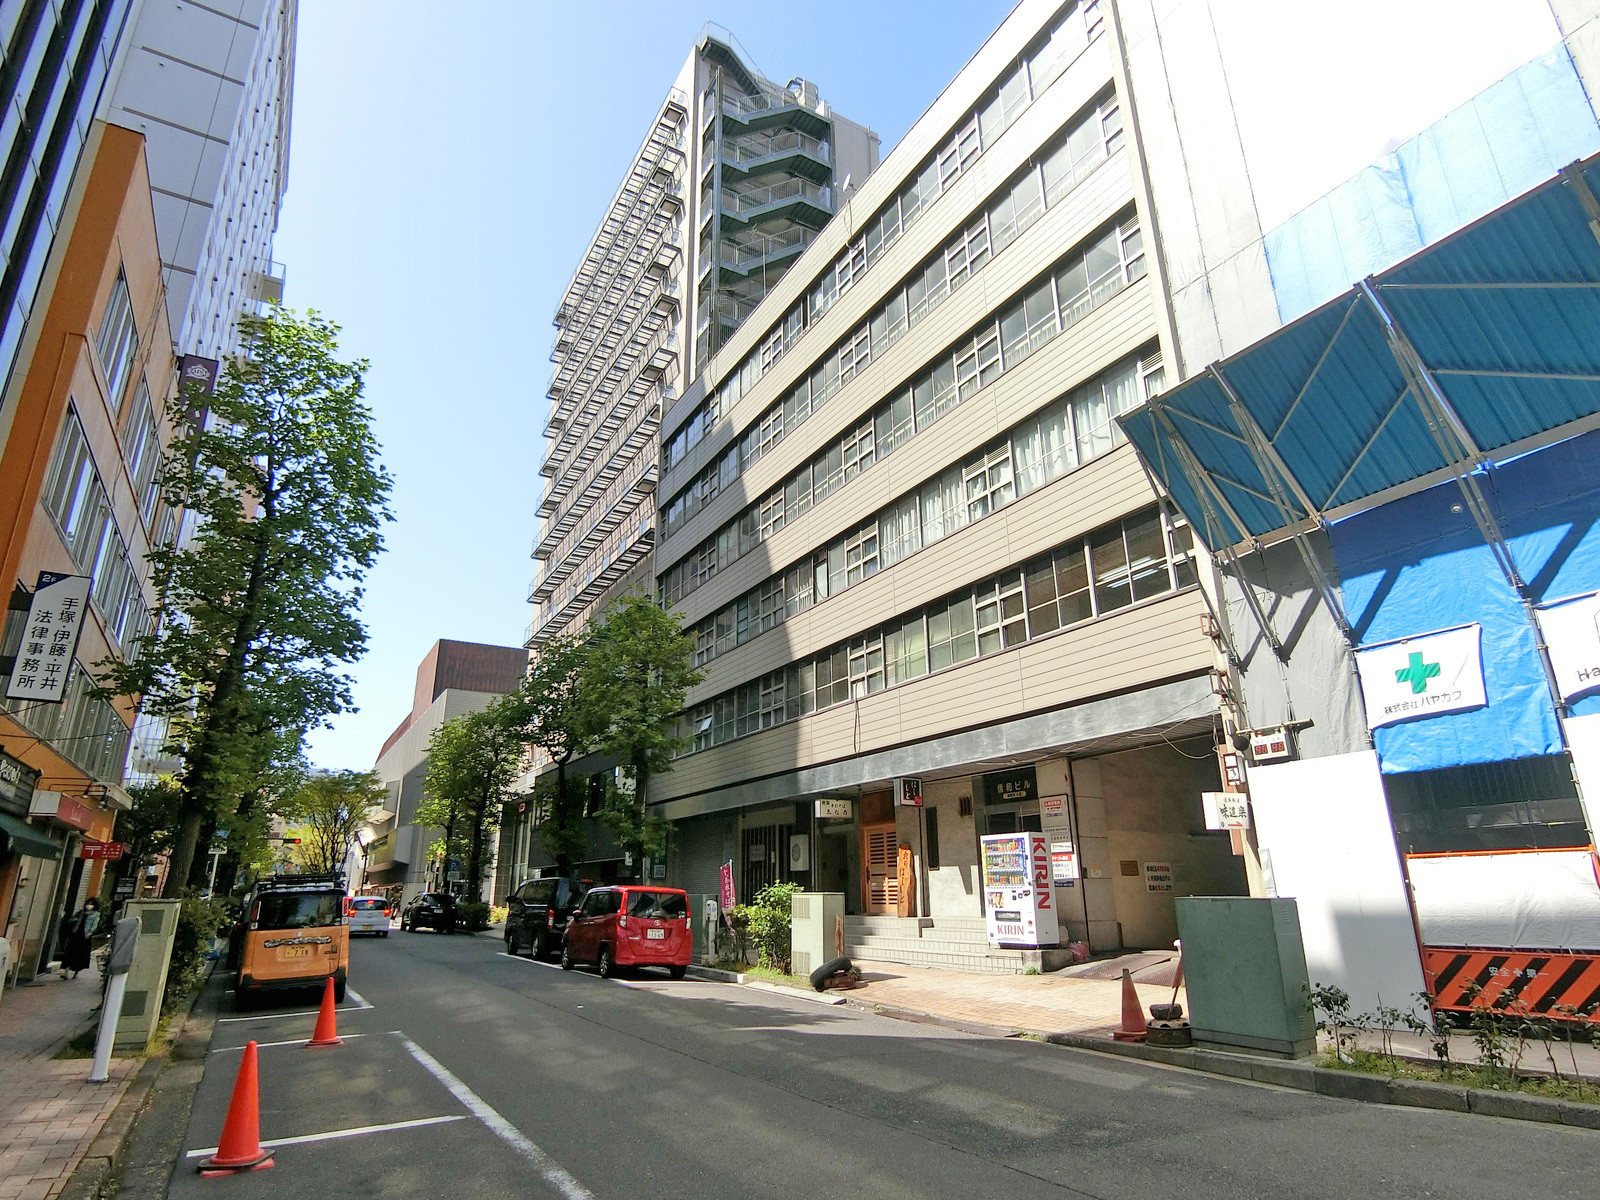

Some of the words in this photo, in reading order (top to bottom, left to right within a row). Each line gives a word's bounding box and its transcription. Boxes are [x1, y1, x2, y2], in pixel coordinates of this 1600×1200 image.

[42, 574, 57, 583] 2F
[16, 609, 54, 689] 法律事務所
[39, 597, 79, 691] 手塚・伊藤・平井
[1032, 837, 1051, 909] KIRIN
[997, 924, 1024, 935] KIRIN
[1489, 967, 1509, 977] 安全
